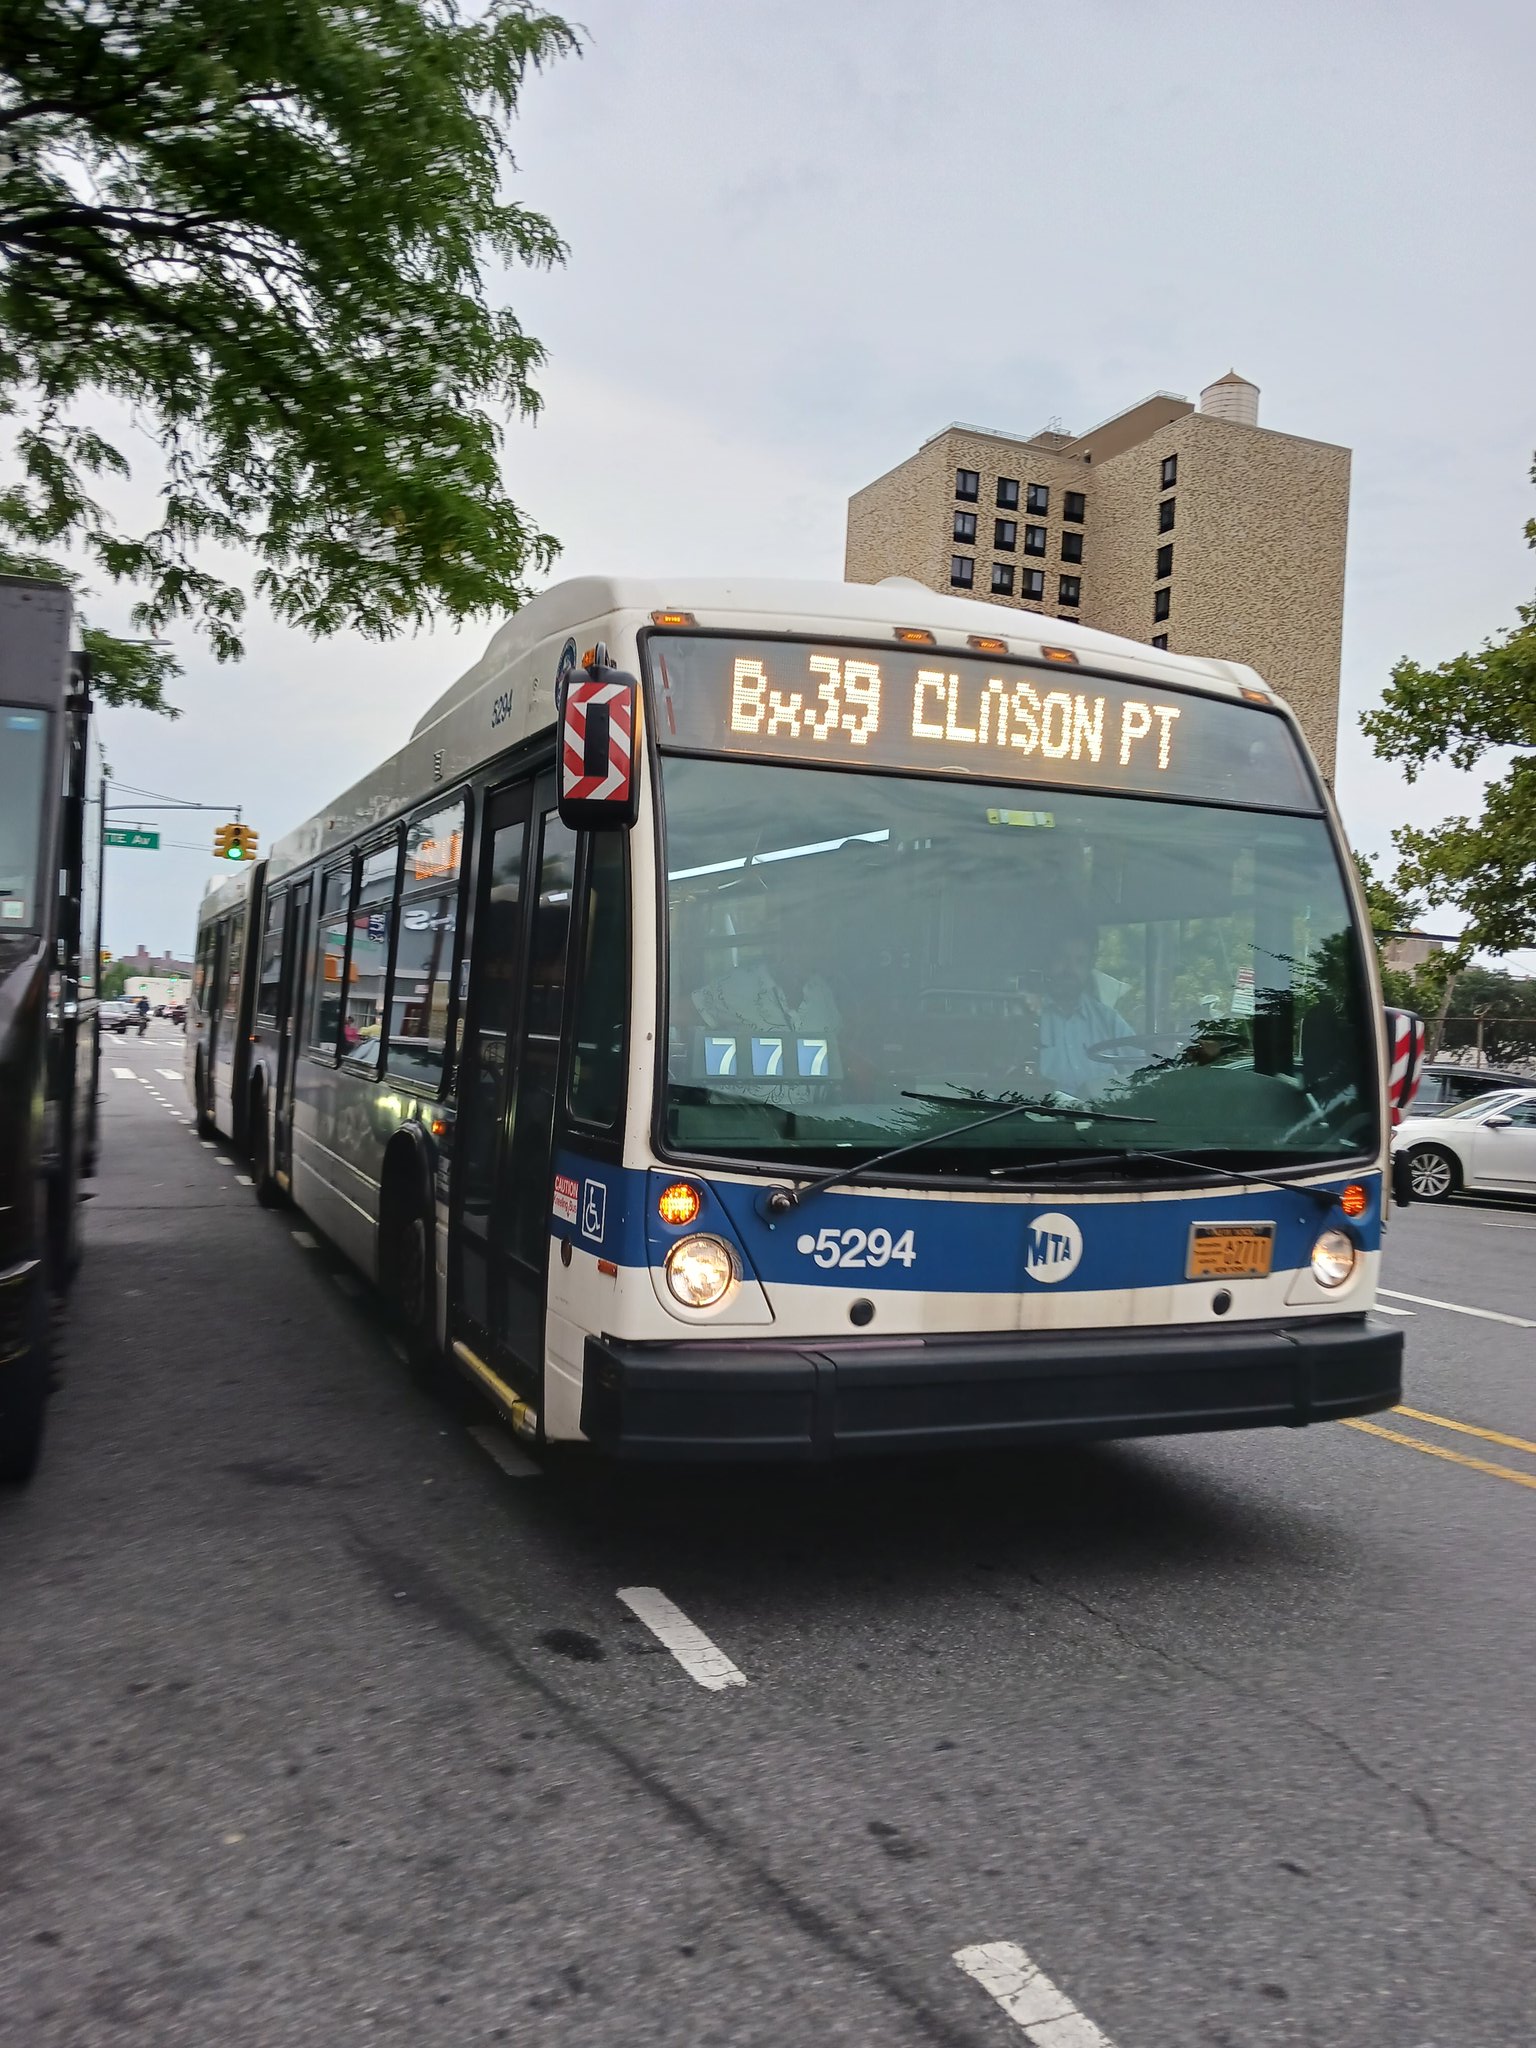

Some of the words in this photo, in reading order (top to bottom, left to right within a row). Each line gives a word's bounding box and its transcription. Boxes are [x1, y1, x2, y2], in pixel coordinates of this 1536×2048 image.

[491, 688, 513, 728] 5294
[731, 655, 881, 744] Bx39
[1120, 701, 1181, 769] PT
[554, 1175, 579, 1199] CAUTION
[813, 1227, 917, 1269] 5294
[1024, 1226, 1073, 1269] MTA
